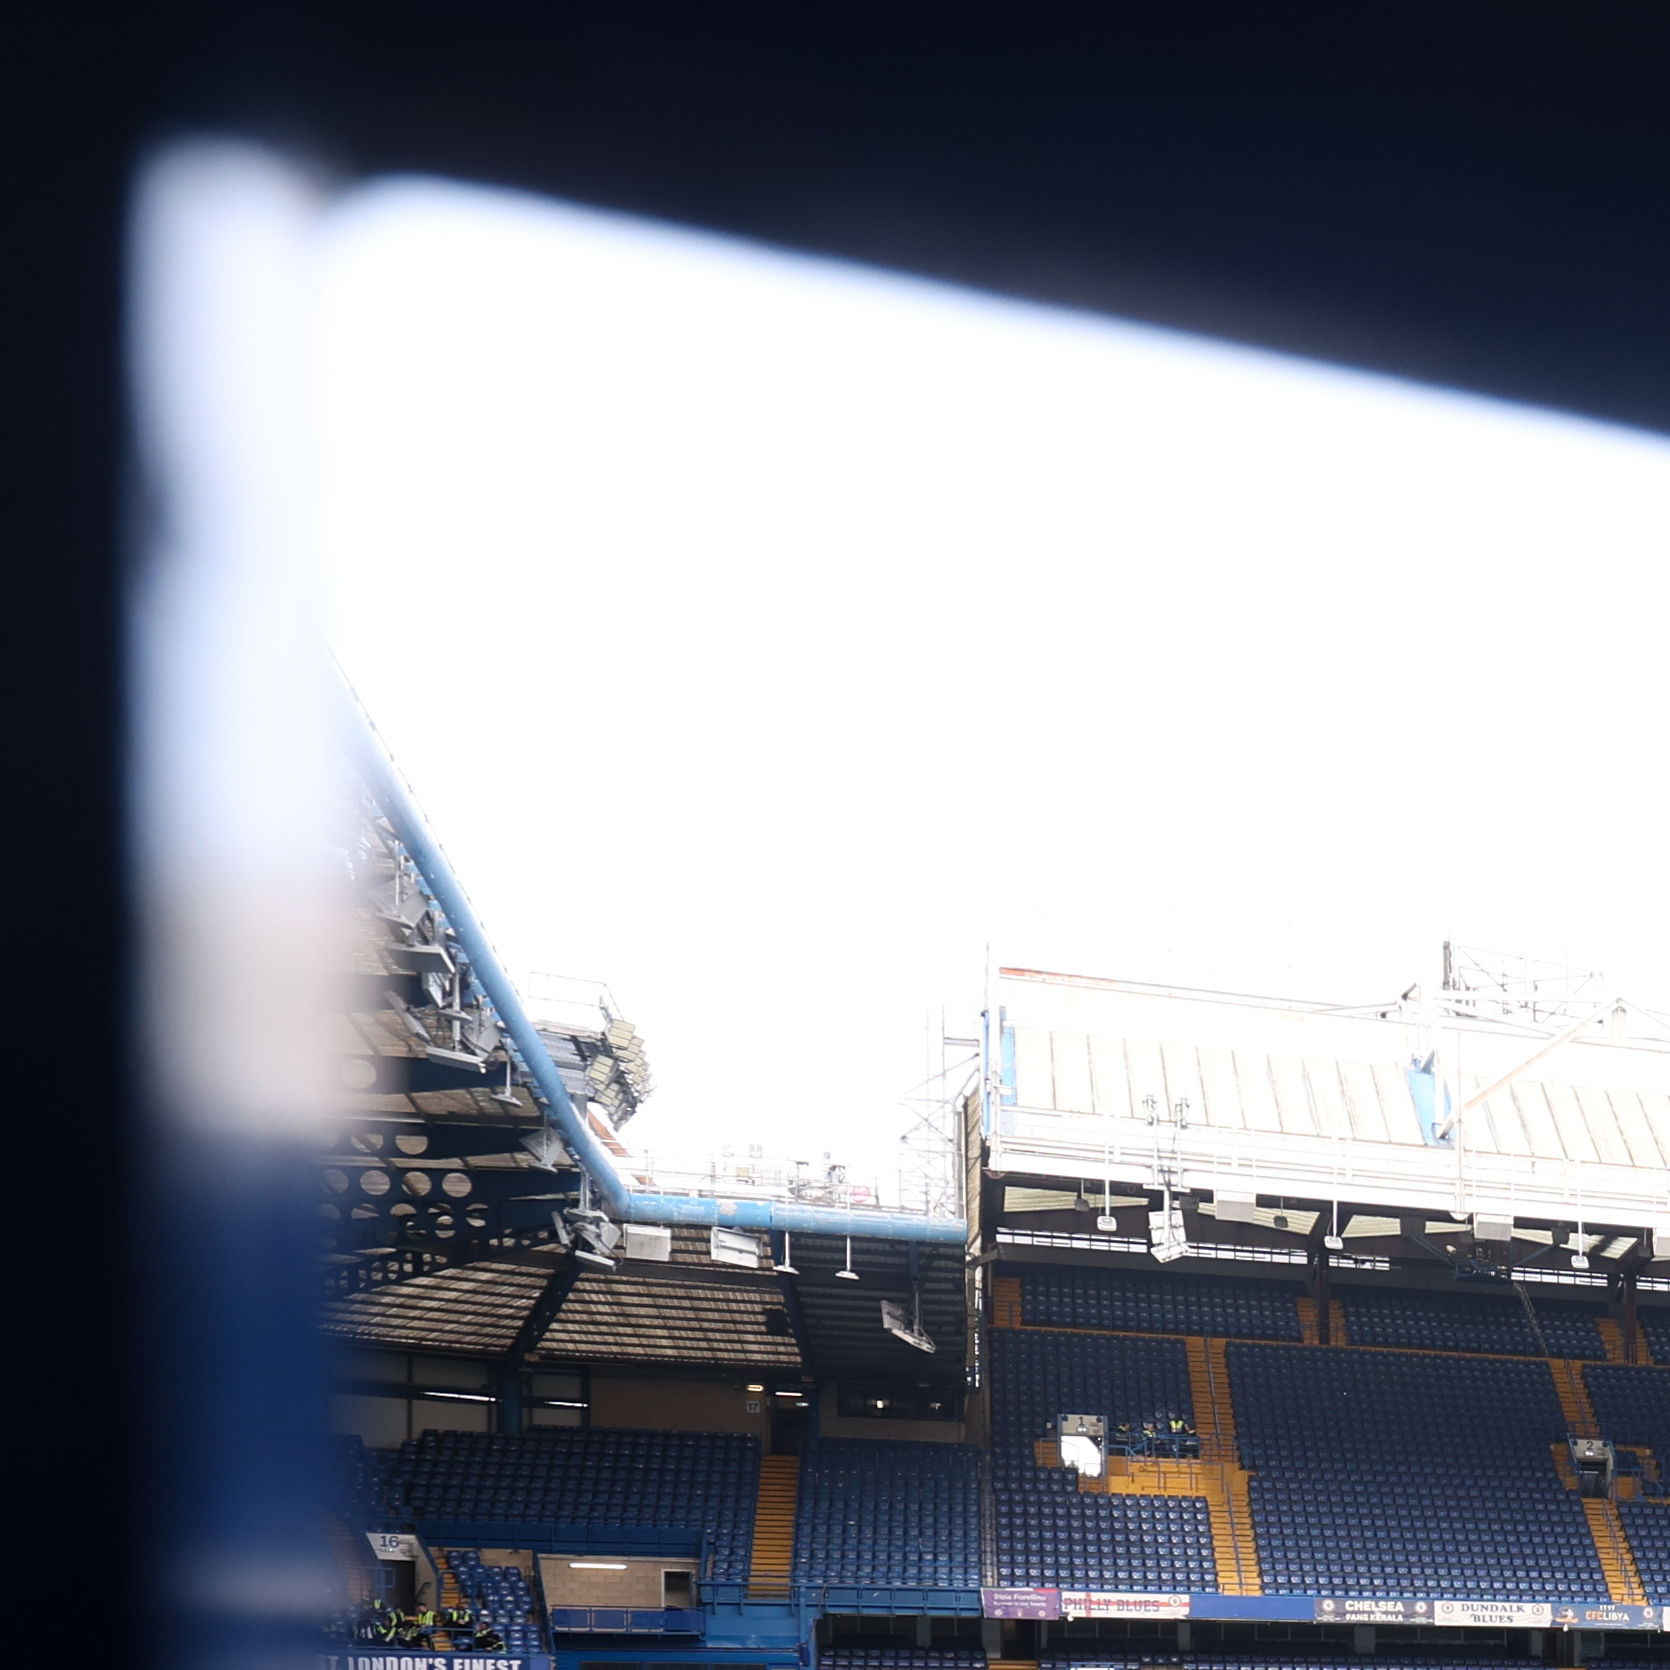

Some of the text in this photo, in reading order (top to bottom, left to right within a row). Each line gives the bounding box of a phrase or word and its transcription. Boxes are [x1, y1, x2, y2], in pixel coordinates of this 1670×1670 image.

[748, 1403, 758, 1412] 17
[1078, 1416, 1084, 1426] 1
[1586, 1441, 1593, 1450] 2
[379, 1535, 399, 1548] 16
[1063, 1597, 1160, 1612] PHILLY BLUES
[1345, 1601, 1405, 1612] CHELSEA
[1461, 1603, 1525, 1613] DUNDALK
[1346, 1613, 1369, 1622] FANS
[1370, 1614, 1403, 1622] KERALA
[1470, 1613, 1514, 1623] BLUES
